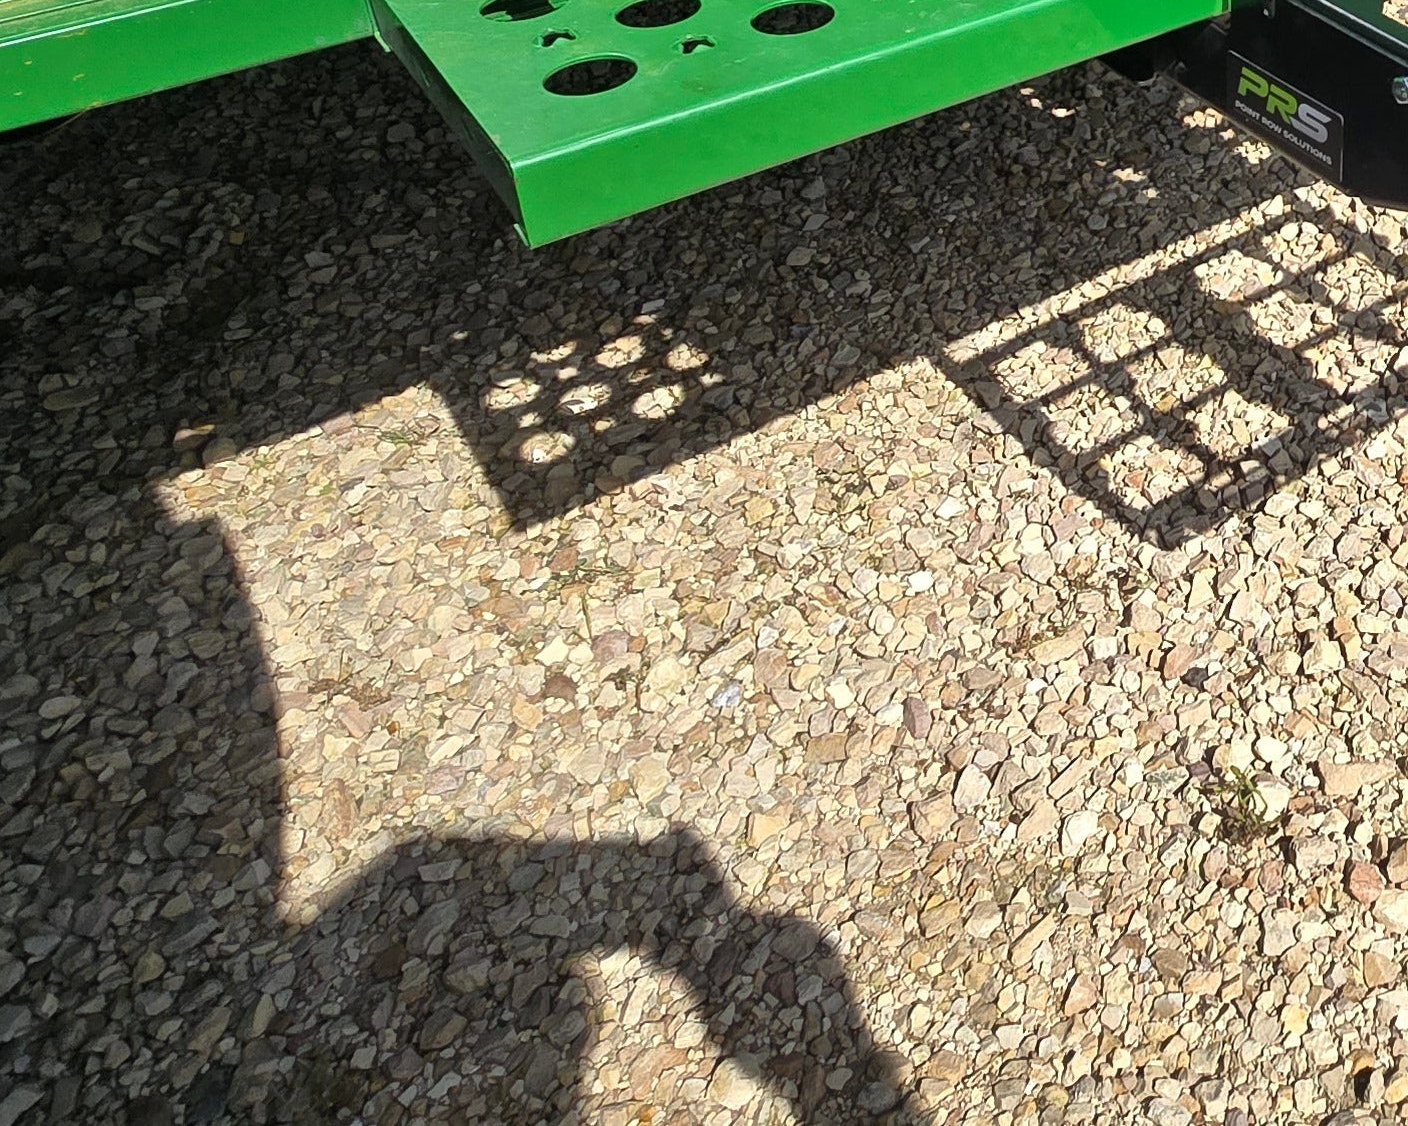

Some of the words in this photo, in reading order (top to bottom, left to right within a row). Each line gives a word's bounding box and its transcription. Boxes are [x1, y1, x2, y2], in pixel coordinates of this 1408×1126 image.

[1235, 100, 1260, 120] POINT
[1262, 117, 1282, 134] ROW
[1283, 130, 1332, 165] SOLUTIONS
[1238, 67, 1332, 143] PRS
